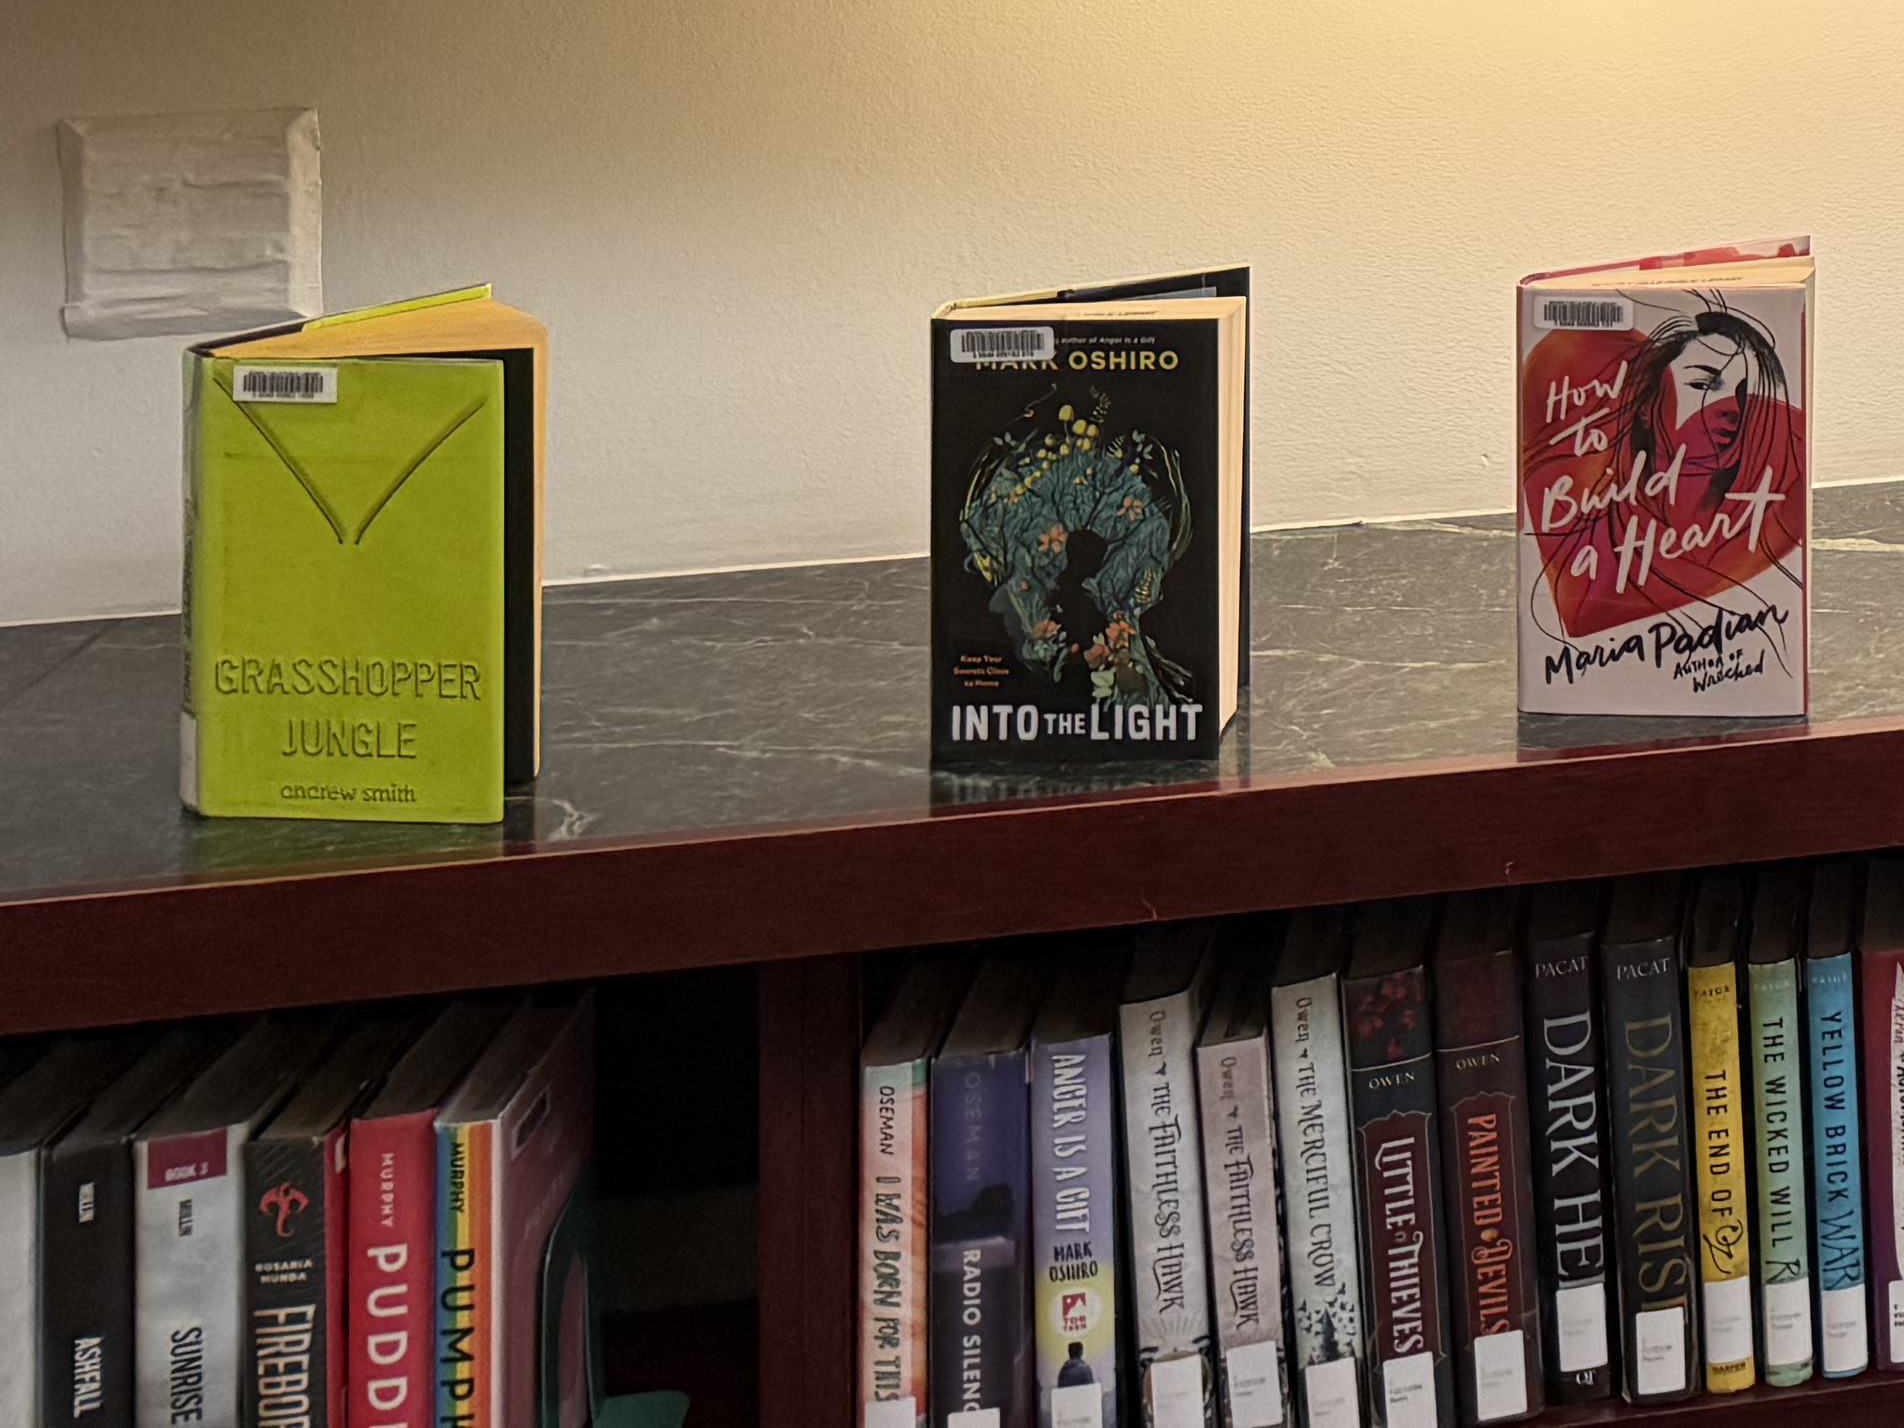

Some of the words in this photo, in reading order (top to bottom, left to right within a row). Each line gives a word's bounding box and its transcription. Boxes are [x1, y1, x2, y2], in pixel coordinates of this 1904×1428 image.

[1068, 350, 1180, 370] OSHIRO
[1546, 360, 1627, 424] How
[1549, 407, 1609, 457] to
[1541, 443, 1687, 532] Build
[1571, 544, 1598, 580] a
[1616, 466, 1785, 593] Heart
[1545, 631, 1645, 685] Maria
[1649, 600, 1789, 669] Padian
[214, 656, 482, 702] GRASSHOPPER
[281, 717, 418, 759] JUNGLE
[951, 704, 1039, 741] INTO
[1044, 713, 1087, 736] THE
[1090, 703, 1204, 741] LIGHT
[363, 781, 417, 804] smith
[1616, 957, 1670, 980] PACAT
[1051, 1054, 1087, 1131] ANGER
[1368, 1070, 1416, 1089] OWEN
[1543, 1011, 1600, 1175] DARK
[1704, 1069, 1726, 1116] THE
[1821, 1012, 1846, 1111] YELLOW
[878, 1085, 897, 1157] OSEMAN
[1708, 1128, 1730, 1176] END
[1764, 1078, 1790, 1172] WICKED
[1825, 1125, 1848, 1209] BRICK
[1054, 1189, 1090, 1232] GIFT
[962, 1248, 982, 1327] RADIO
[73, 1336, 105, 1418] ASHFALL
[169, 1326, 203, 1425] SUNRISE
